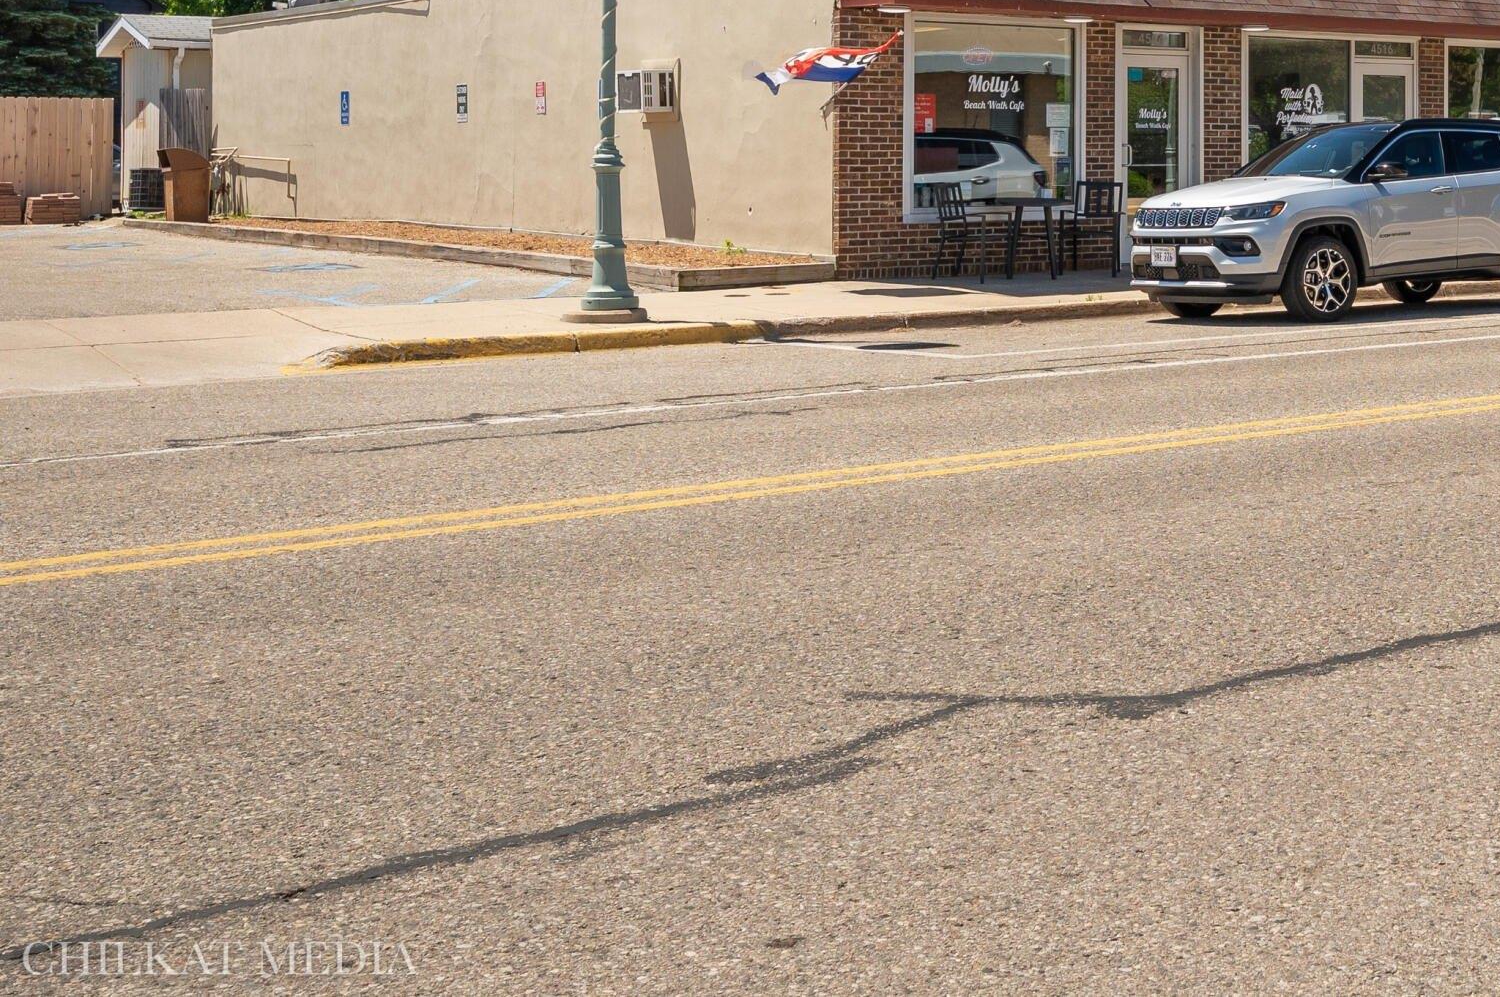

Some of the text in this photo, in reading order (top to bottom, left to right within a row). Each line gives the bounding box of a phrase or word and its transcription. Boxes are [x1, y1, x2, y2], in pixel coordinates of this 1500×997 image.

[968, 74, 1021, 99] Molly's
[1280, 87, 1305, 102] Maid
[963, 100, 987, 110] Beach
[986, 100, 1008, 110] Walk
[1284, 100, 1303, 111] with
[1138, 107, 1168, 122] Molly's
